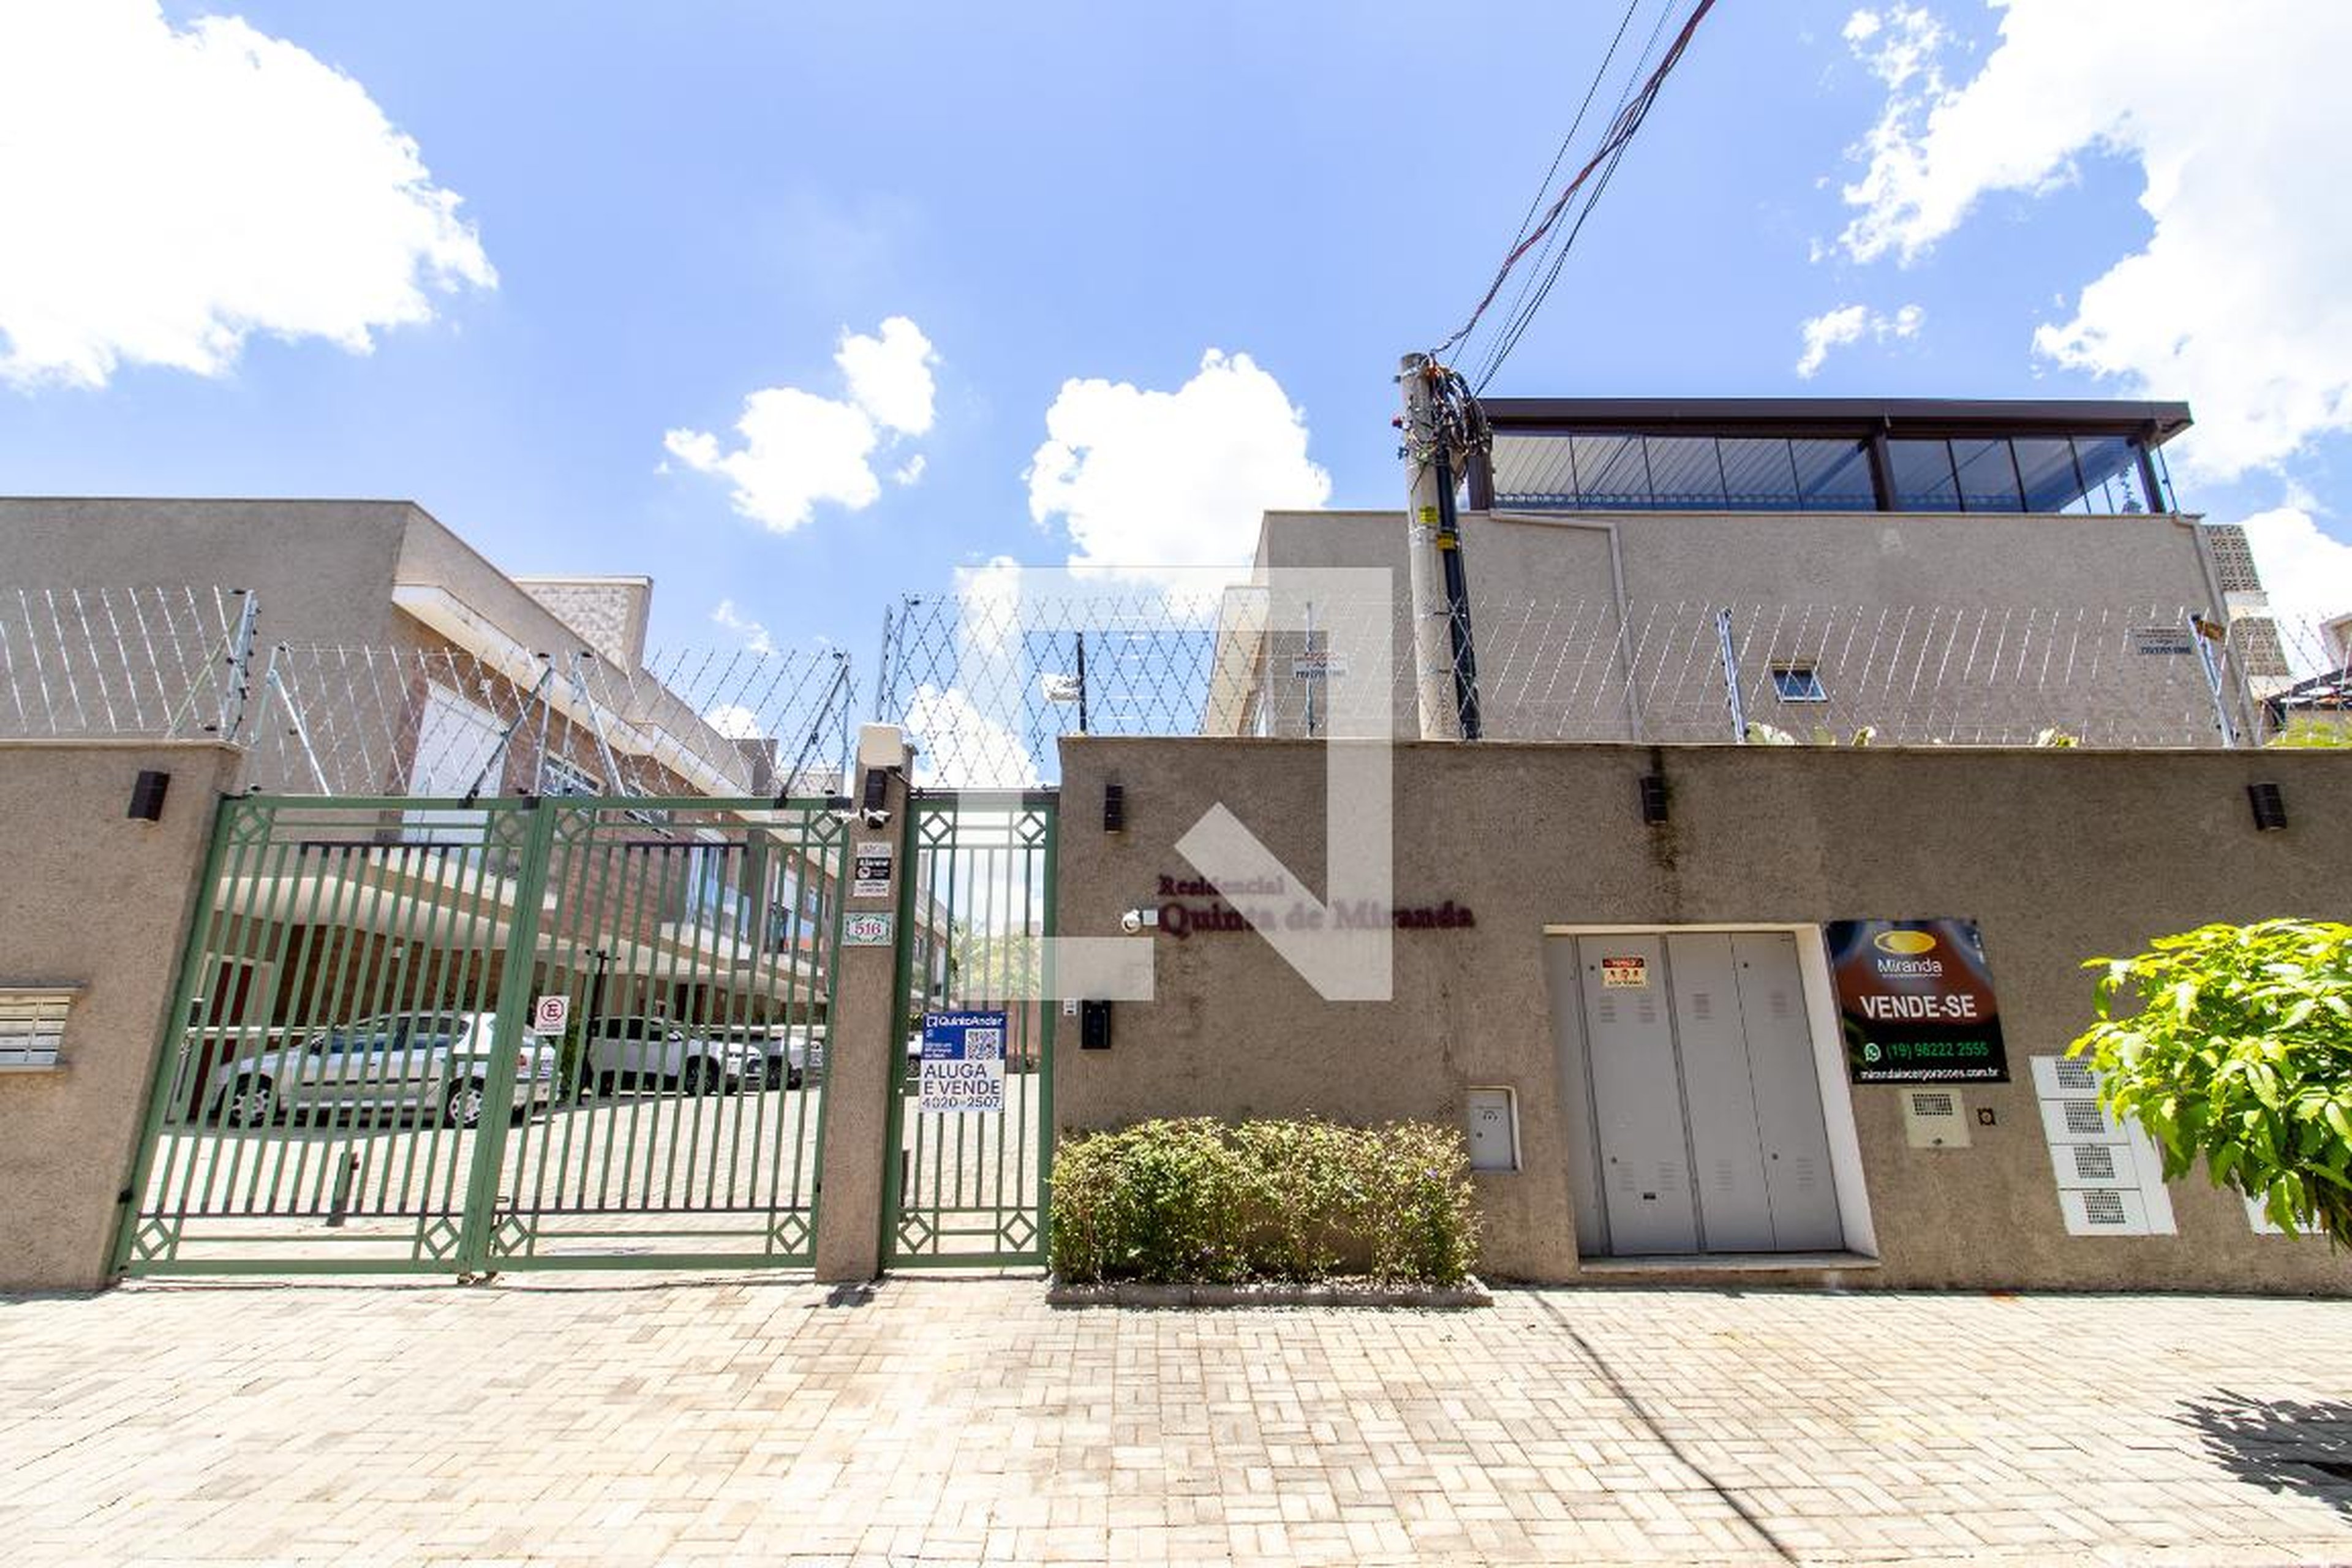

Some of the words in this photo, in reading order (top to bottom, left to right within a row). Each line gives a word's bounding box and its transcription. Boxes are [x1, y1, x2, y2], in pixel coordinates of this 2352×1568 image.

[1158, 874, 1284, 896] Residencial
[1158, 902, 1277, 941] Quinta
[1285, 902, 1323, 931] de
[1333, 899, 1476, 930] Miranda
[855, 922, 881, 935] 516
[1877, 957, 1943, 973] Miranda
[546, 1004, 558, 1017] E
[1860, 995, 1977, 1017] VENDE-SE
[938, 1016, 1003, 1026] QuintoAndar
[1887, 1043, 1912, 1060] (19)
[924, 1063, 987, 1079] ALUGA
[925, 1081, 933, 1095] E
[938, 1080, 1000, 1095] VENDE
